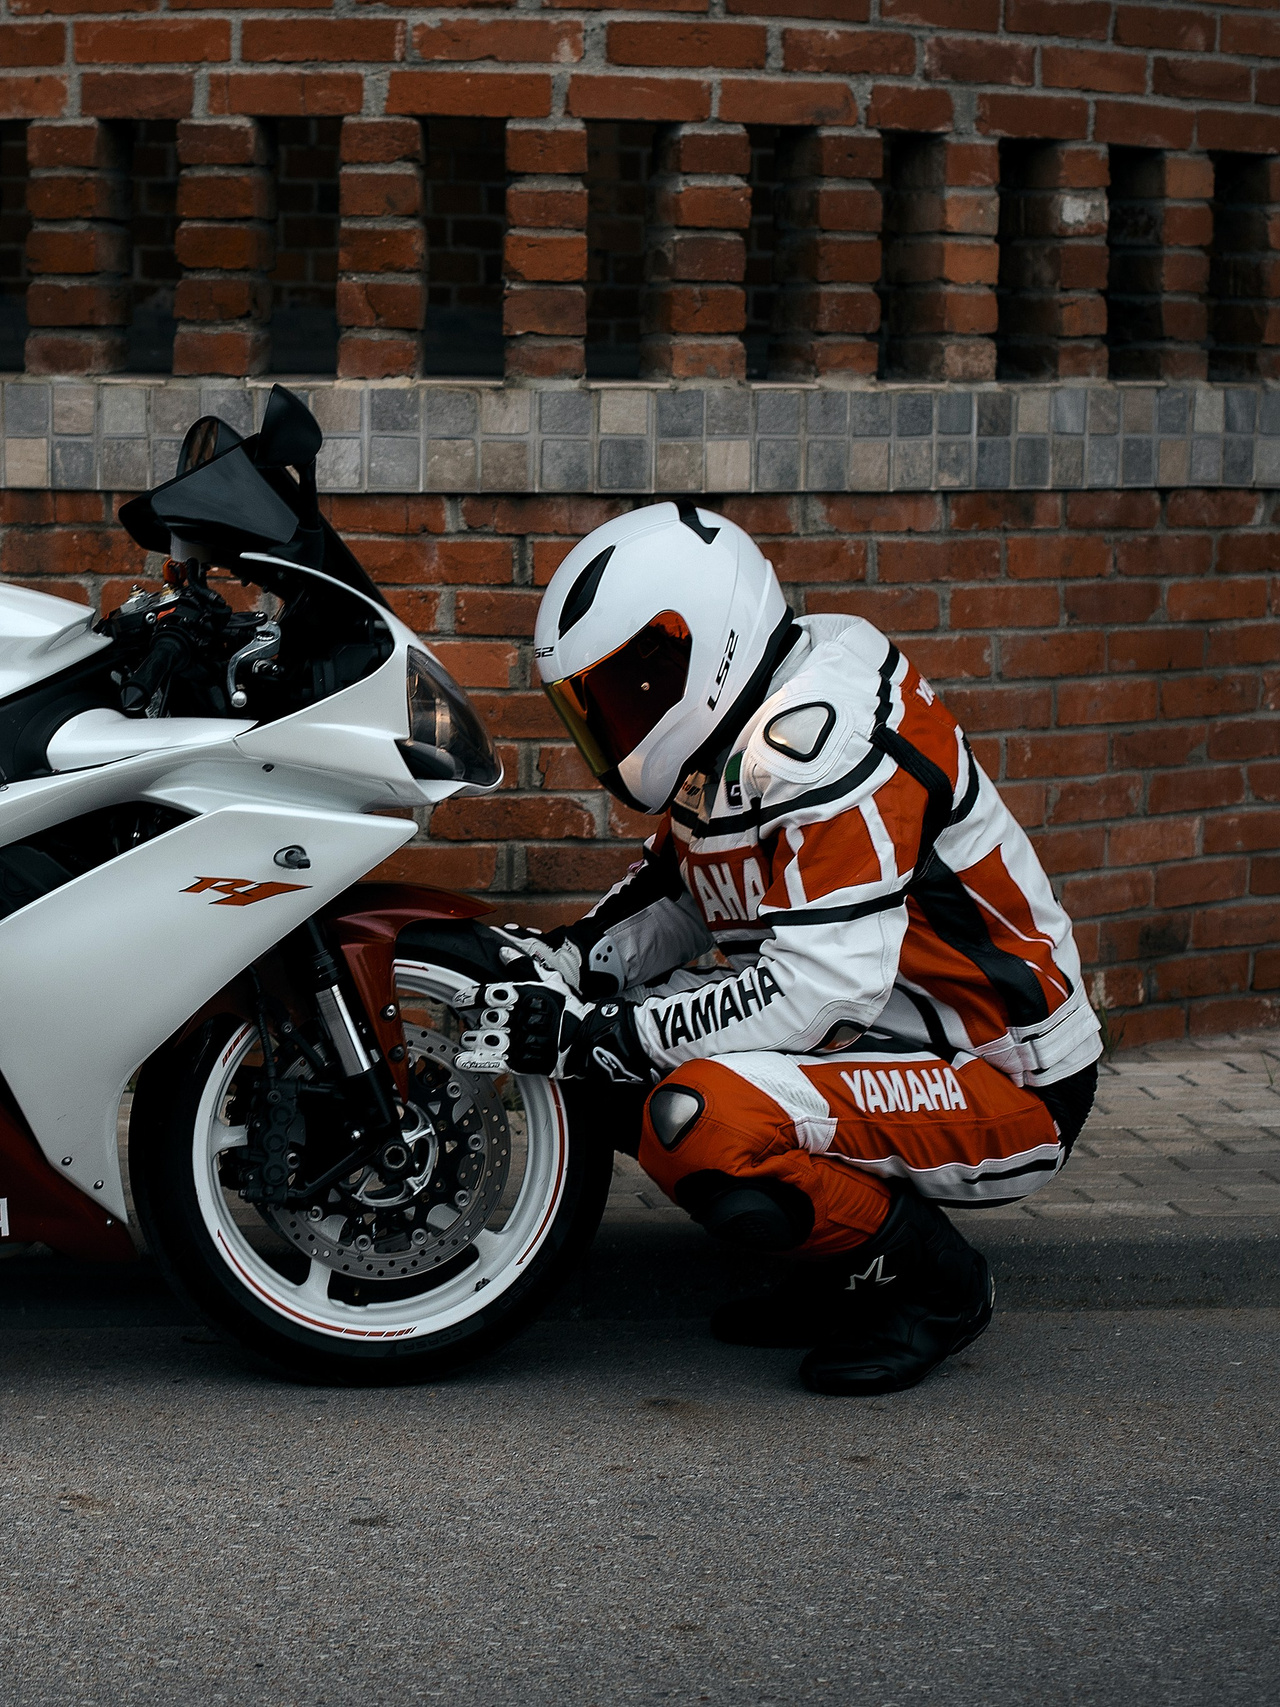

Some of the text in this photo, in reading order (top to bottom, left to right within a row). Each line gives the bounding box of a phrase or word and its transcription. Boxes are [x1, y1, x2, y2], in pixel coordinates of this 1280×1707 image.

[707, 628, 739, 711] LS2
[178, 876, 313, 906] R1
[650, 966, 786, 1050] YAMAHA
[840, 1067, 968, 1113] YAMAHA
[402, 1327, 464, 1350] CORSA
